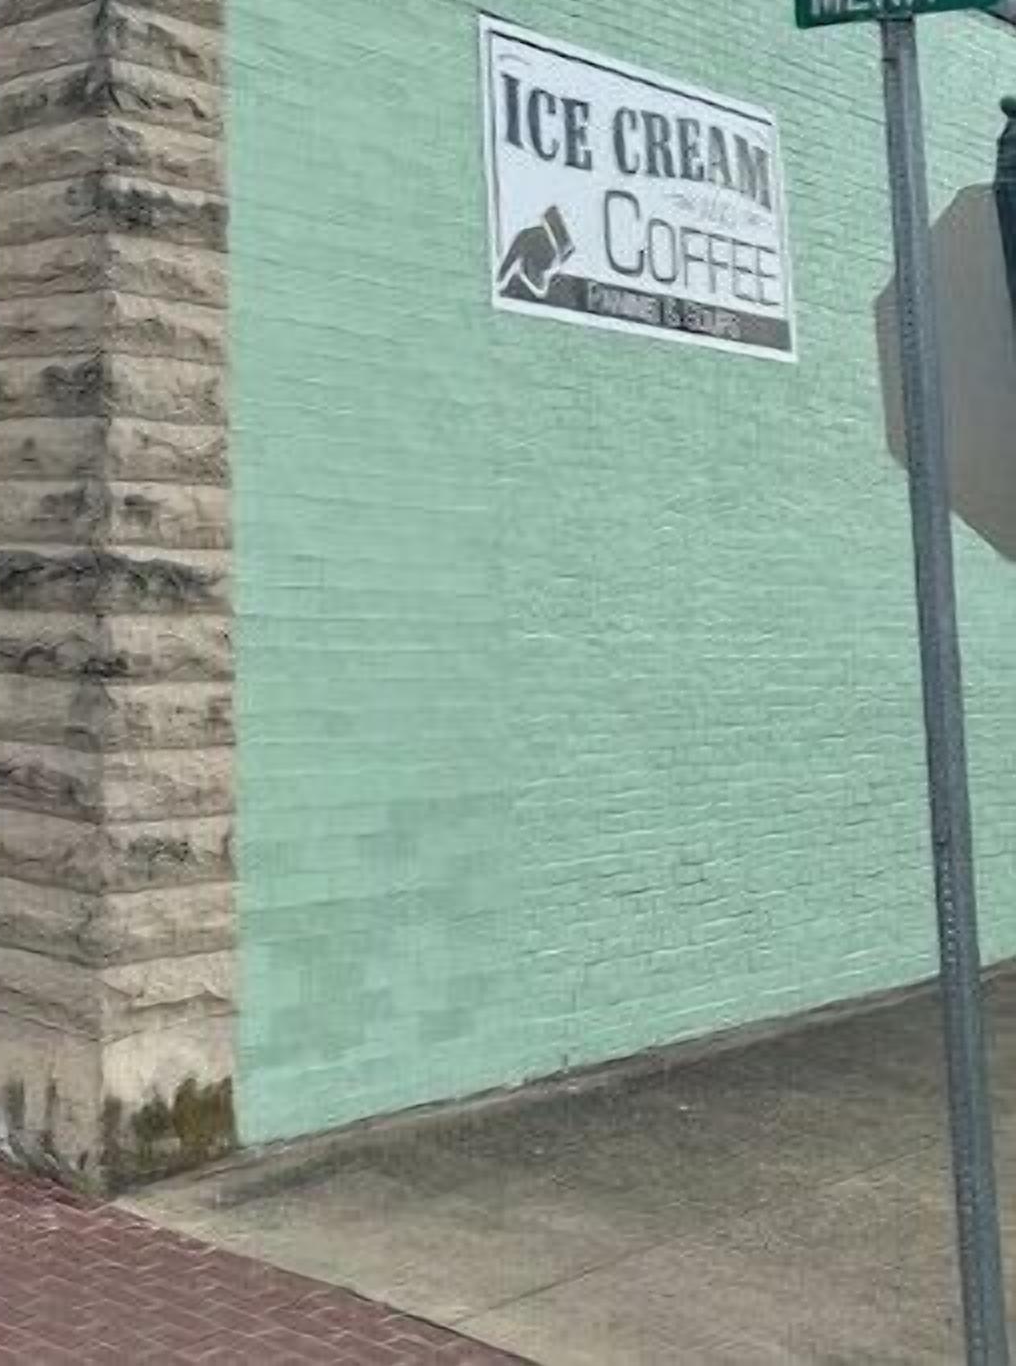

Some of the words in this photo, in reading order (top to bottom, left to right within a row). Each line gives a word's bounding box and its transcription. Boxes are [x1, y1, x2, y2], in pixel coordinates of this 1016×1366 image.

[500, 71, 592, 172] ICE
[612, 105, 774, 211] CREAM
[604, 189, 781, 307] COFFEE
